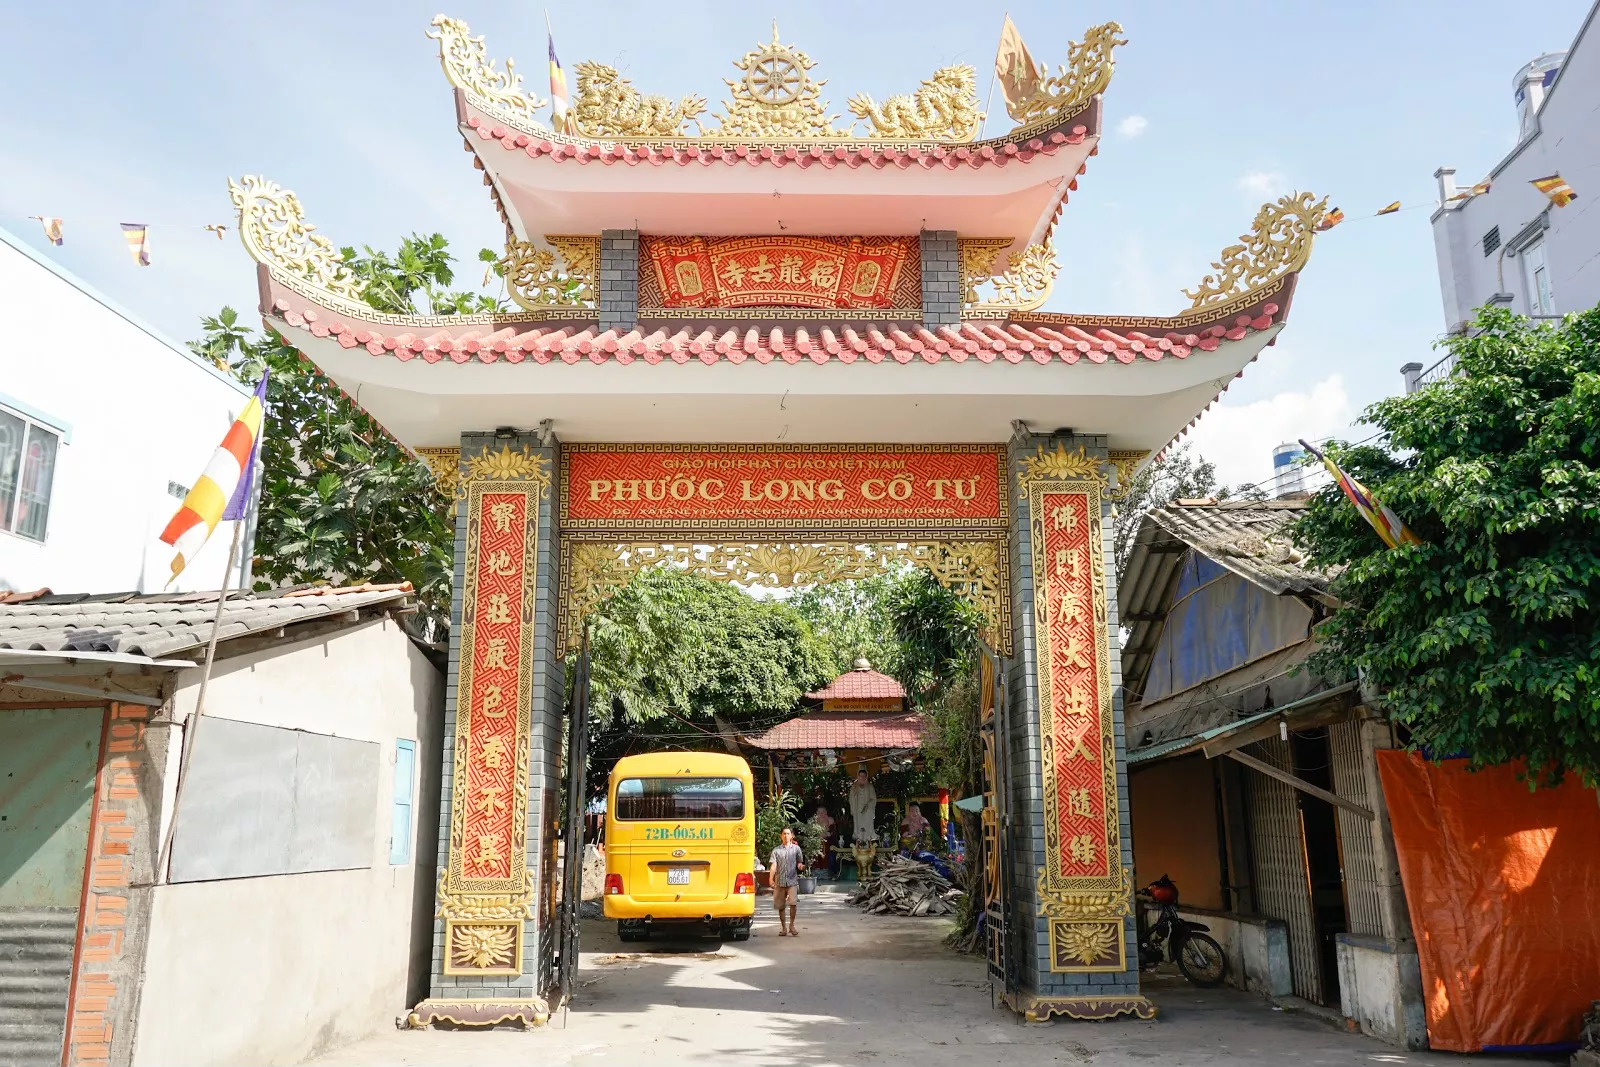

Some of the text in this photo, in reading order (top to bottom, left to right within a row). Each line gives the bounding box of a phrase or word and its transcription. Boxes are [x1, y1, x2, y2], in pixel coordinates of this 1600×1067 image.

[868, 459, 905, 469] NAM
[588, 472, 981, 506] PHƯỚC LONG CỔ TỰ
[646, 828, 713, 840] 72B-005.61
